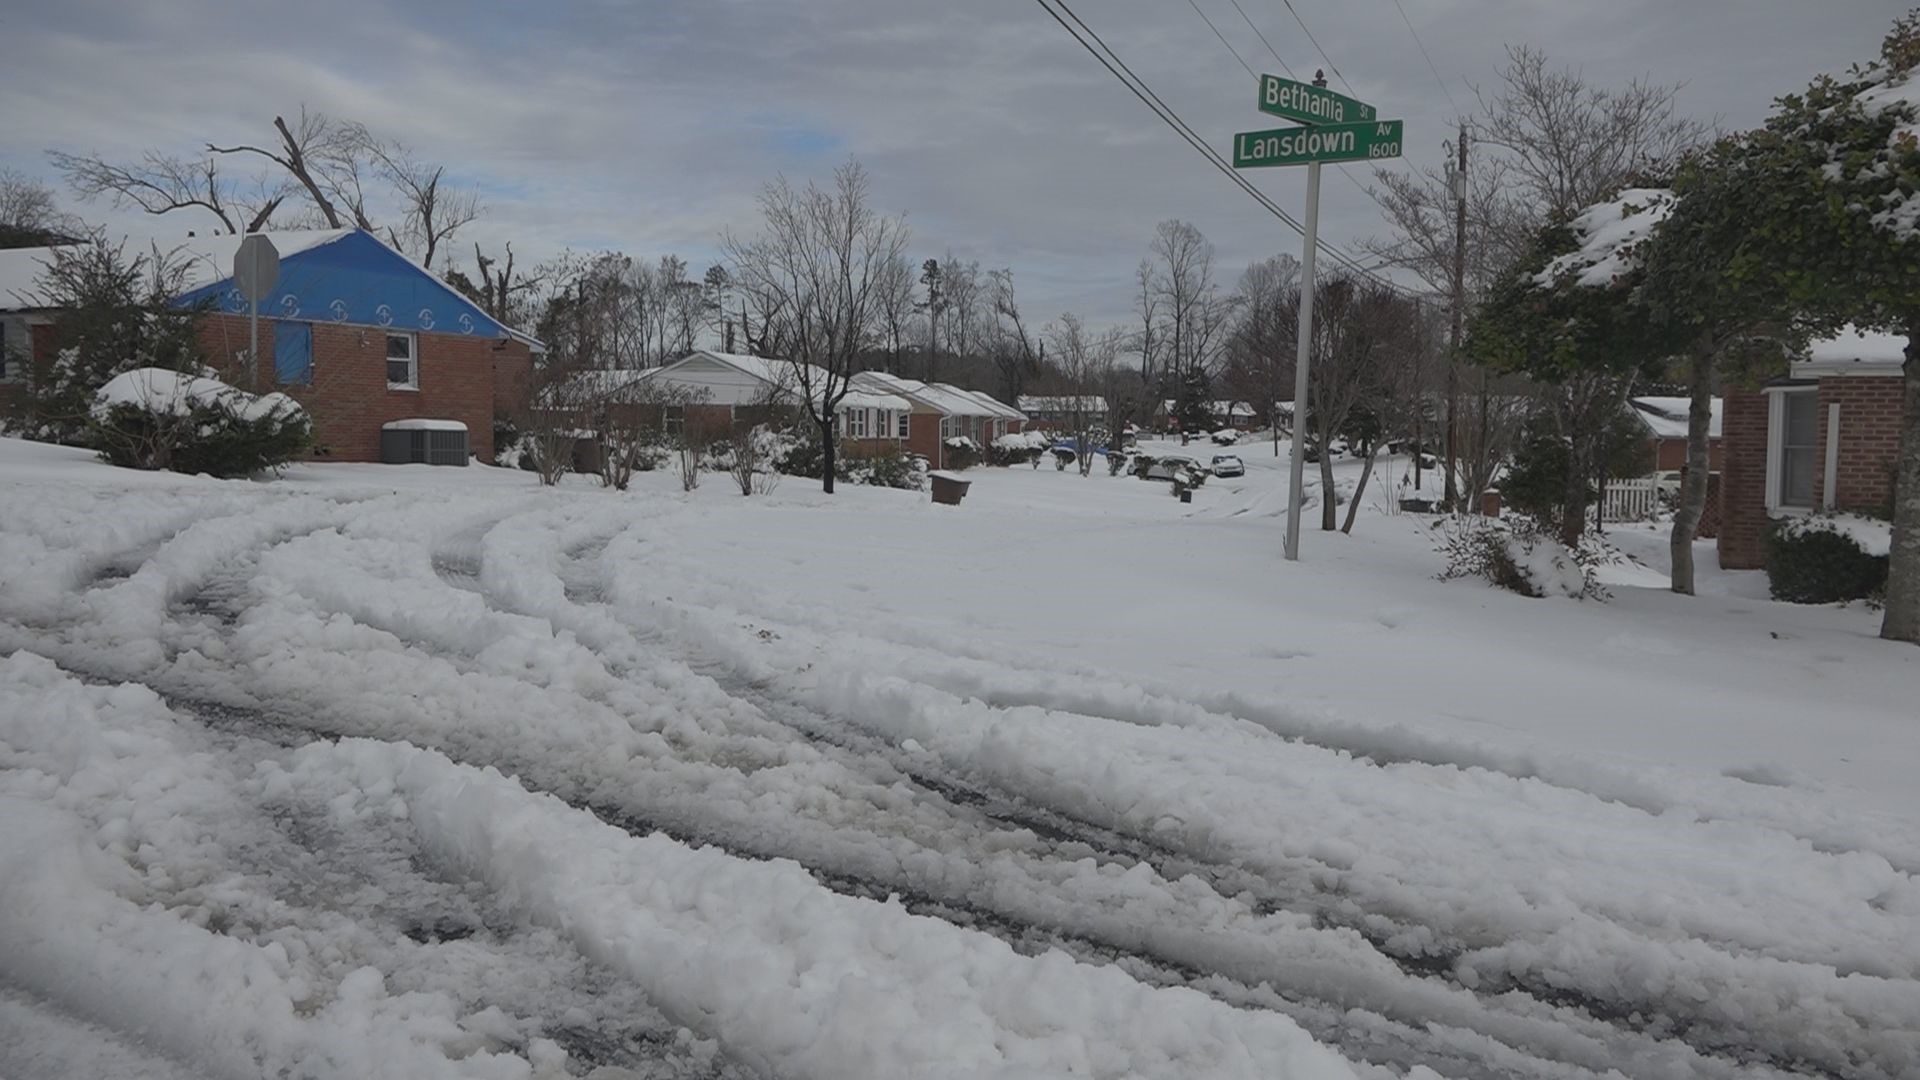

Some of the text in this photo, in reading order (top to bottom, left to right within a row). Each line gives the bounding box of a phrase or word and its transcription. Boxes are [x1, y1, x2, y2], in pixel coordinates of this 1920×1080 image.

[1266, 77, 1369, 122] Bethania St
[1239, 123, 1392, 160] Lansdown Av
[1368, 142, 1399, 157] 1600
